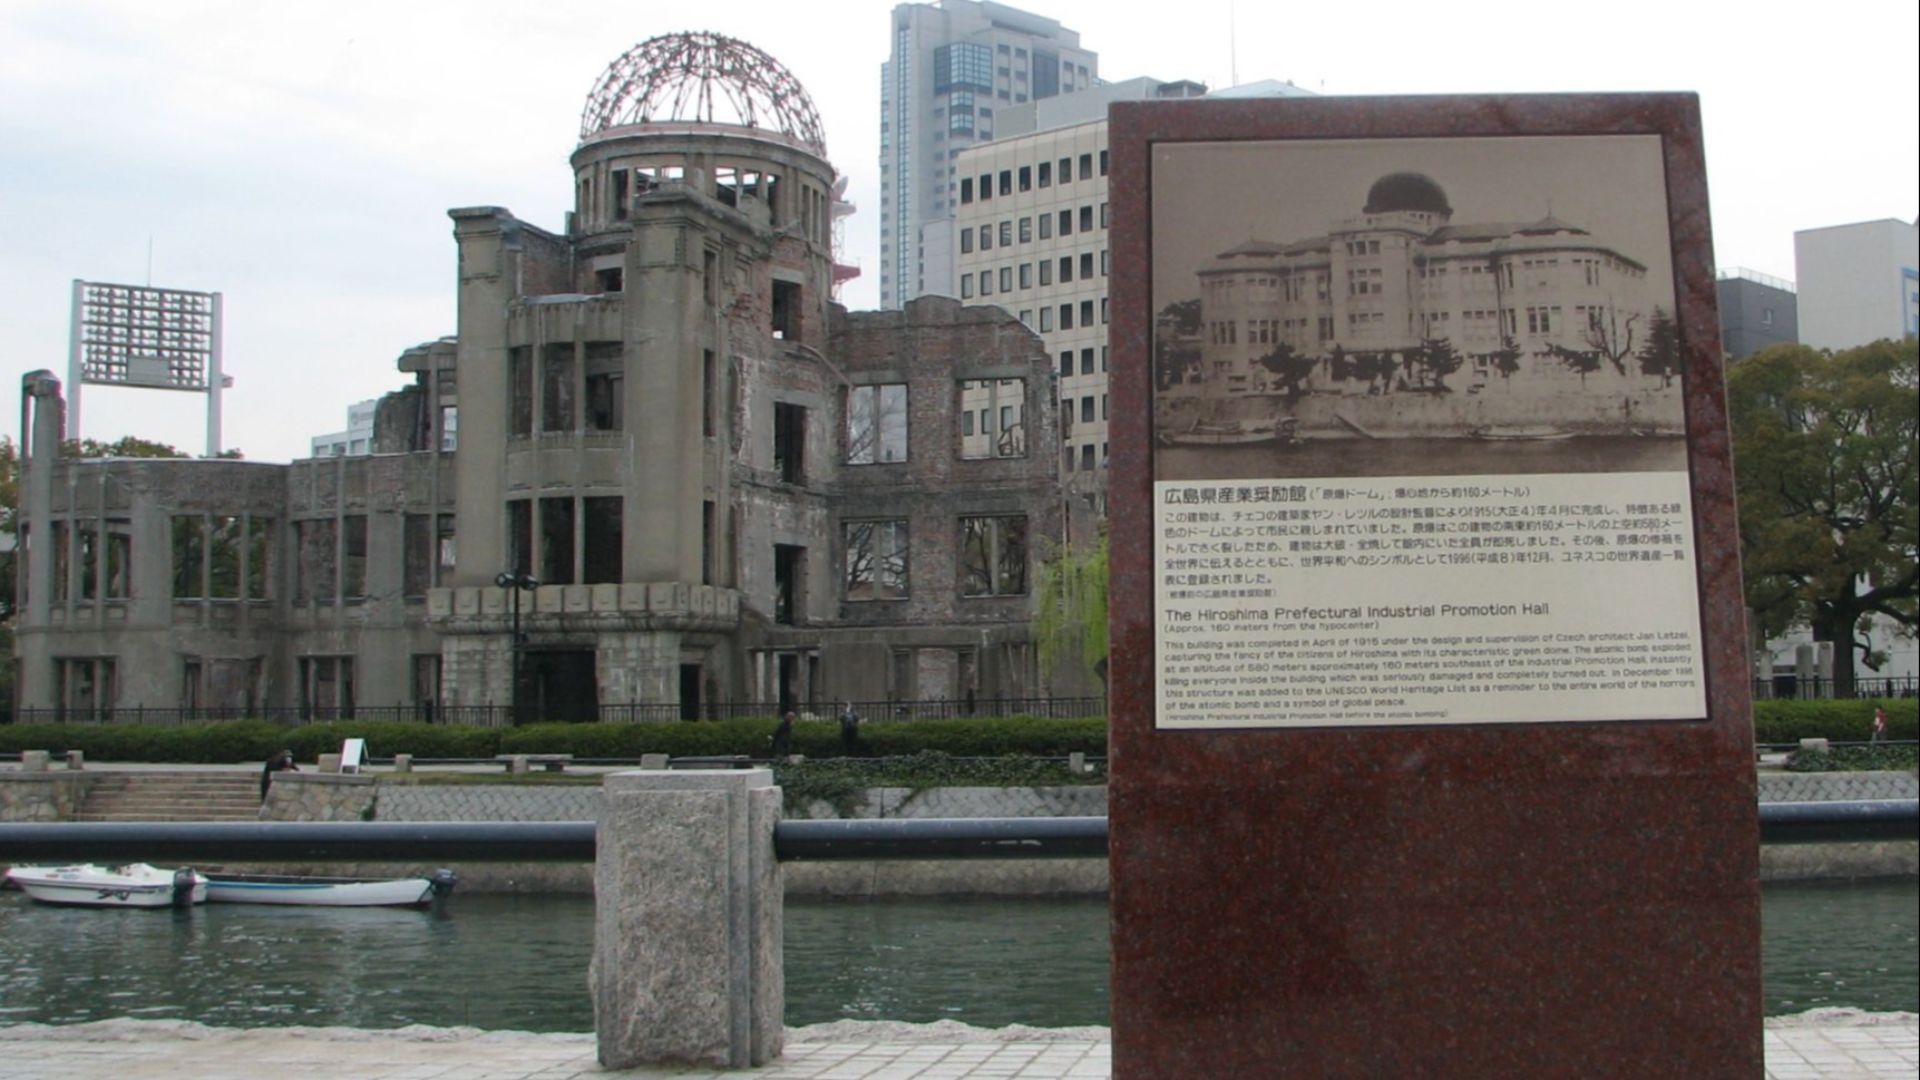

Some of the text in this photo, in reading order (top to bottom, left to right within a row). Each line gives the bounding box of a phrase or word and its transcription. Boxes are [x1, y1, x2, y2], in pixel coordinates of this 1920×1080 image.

[1165, 486, 1306, 504] 広島県産業奨励館
[1165, 603, 1549, 621] The Hiroshima Prefectural Industrial Promotion Hall
[1319, 620, 1379, 631] hypocenter)
[1165, 641, 1184, 649] This
[1187, 640, 1223, 650] building
[1248, 640, 1299, 648] completed
[1313, 639, 1335, 647] April
[1339, 638, 1349, 646] of
[1354, 638, 1378, 646] 1915
[1431, 636, 1462, 645] design
[1486, 635, 1539, 643] supervision
[1556, 633, 1585, 641] Czech
[1637, 632, 1654, 640] Jan
[1165, 653, 1211, 662] capturing
[1234, 652, 1260, 660] fancy
[1297, 650, 1333, 658] citizens
[1337, 650, 1347, 658] of
[1401, 649, 1421, 657] with
[1439, 648, 1510, 657] characteristic
[1513, 648, 1540, 656] green
[1575, 645, 1591, 653] The
[1595, 645, 1624, 653] atomic
[1652, 643, 1691, 652] exploded
[1234, 664, 1244, 672] of
[1272, 663, 1307, 671] meters
[1310, 662, 1378, 671] approximately
[1382, 661, 1402, 669] 160
[1405, 661, 1439, 669] meters
[1494, 659, 1505, 667] of
[1575, 656, 1625, 664] Promotion
[1650, 655, 1691, 664] instantly
[1187, 689, 1233, 697] structure
[1259, 688, 1289, 696] added
[1306, 687, 1322, 695] the
[1325, 686, 1367, 695] UNESCO
[1371, 686, 1397, 694] World
[1401, 685, 1444, 694] Heritage
[1493, 683, 1535, 692] reminder
[1552, 682, 1567, 690] the
[1570, 681, 1597, 689] entire
[1600, 681, 1625, 689] world
[1628, 680, 1638, 688] of
[1641, 680, 1657, 688] the
[1660, 679, 1695, 688] horrors
[1165, 702, 1176, 710] of
[1198, 701, 1231, 709] atomic
[1264, 700, 1281, 708] and
[1293, 699, 1326, 708] symbol
[1343, 698, 1371, 708] global
